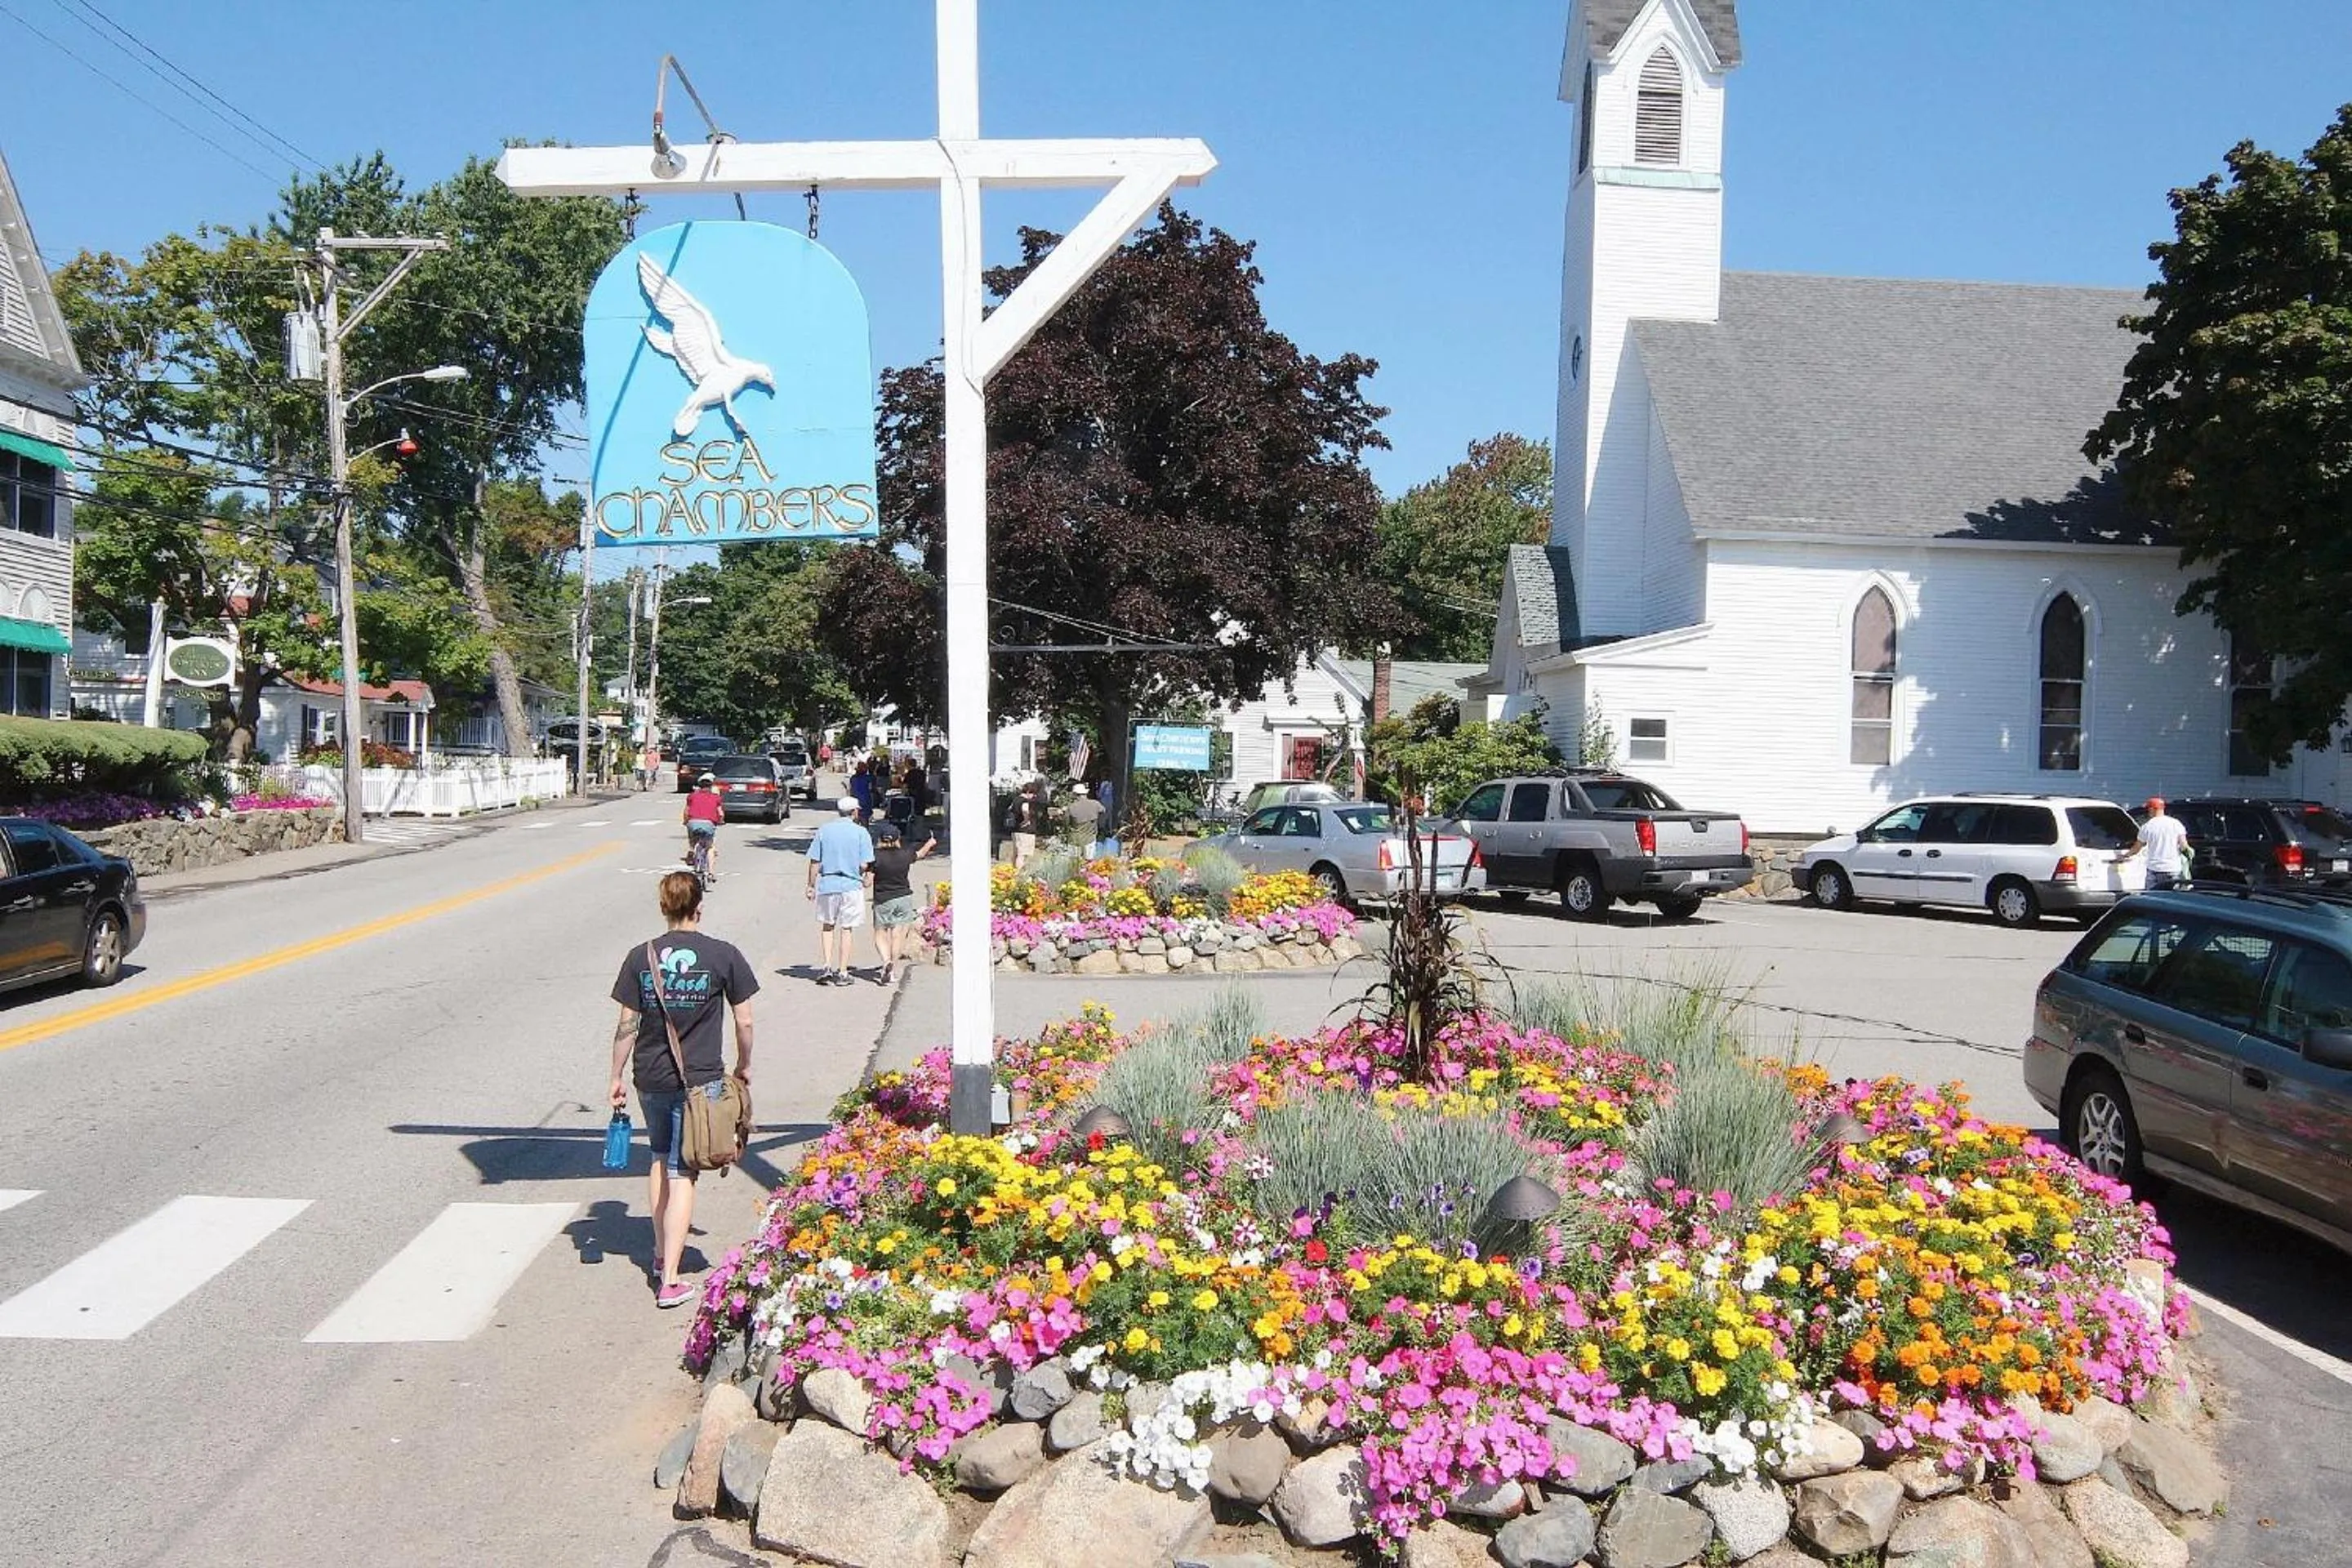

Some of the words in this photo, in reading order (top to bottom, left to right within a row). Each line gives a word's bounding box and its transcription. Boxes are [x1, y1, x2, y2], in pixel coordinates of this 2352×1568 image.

[658, 435, 777, 488] SEA
[595, 483, 876, 539] CHAMBERS
[644, 973, 708, 991] Slash
